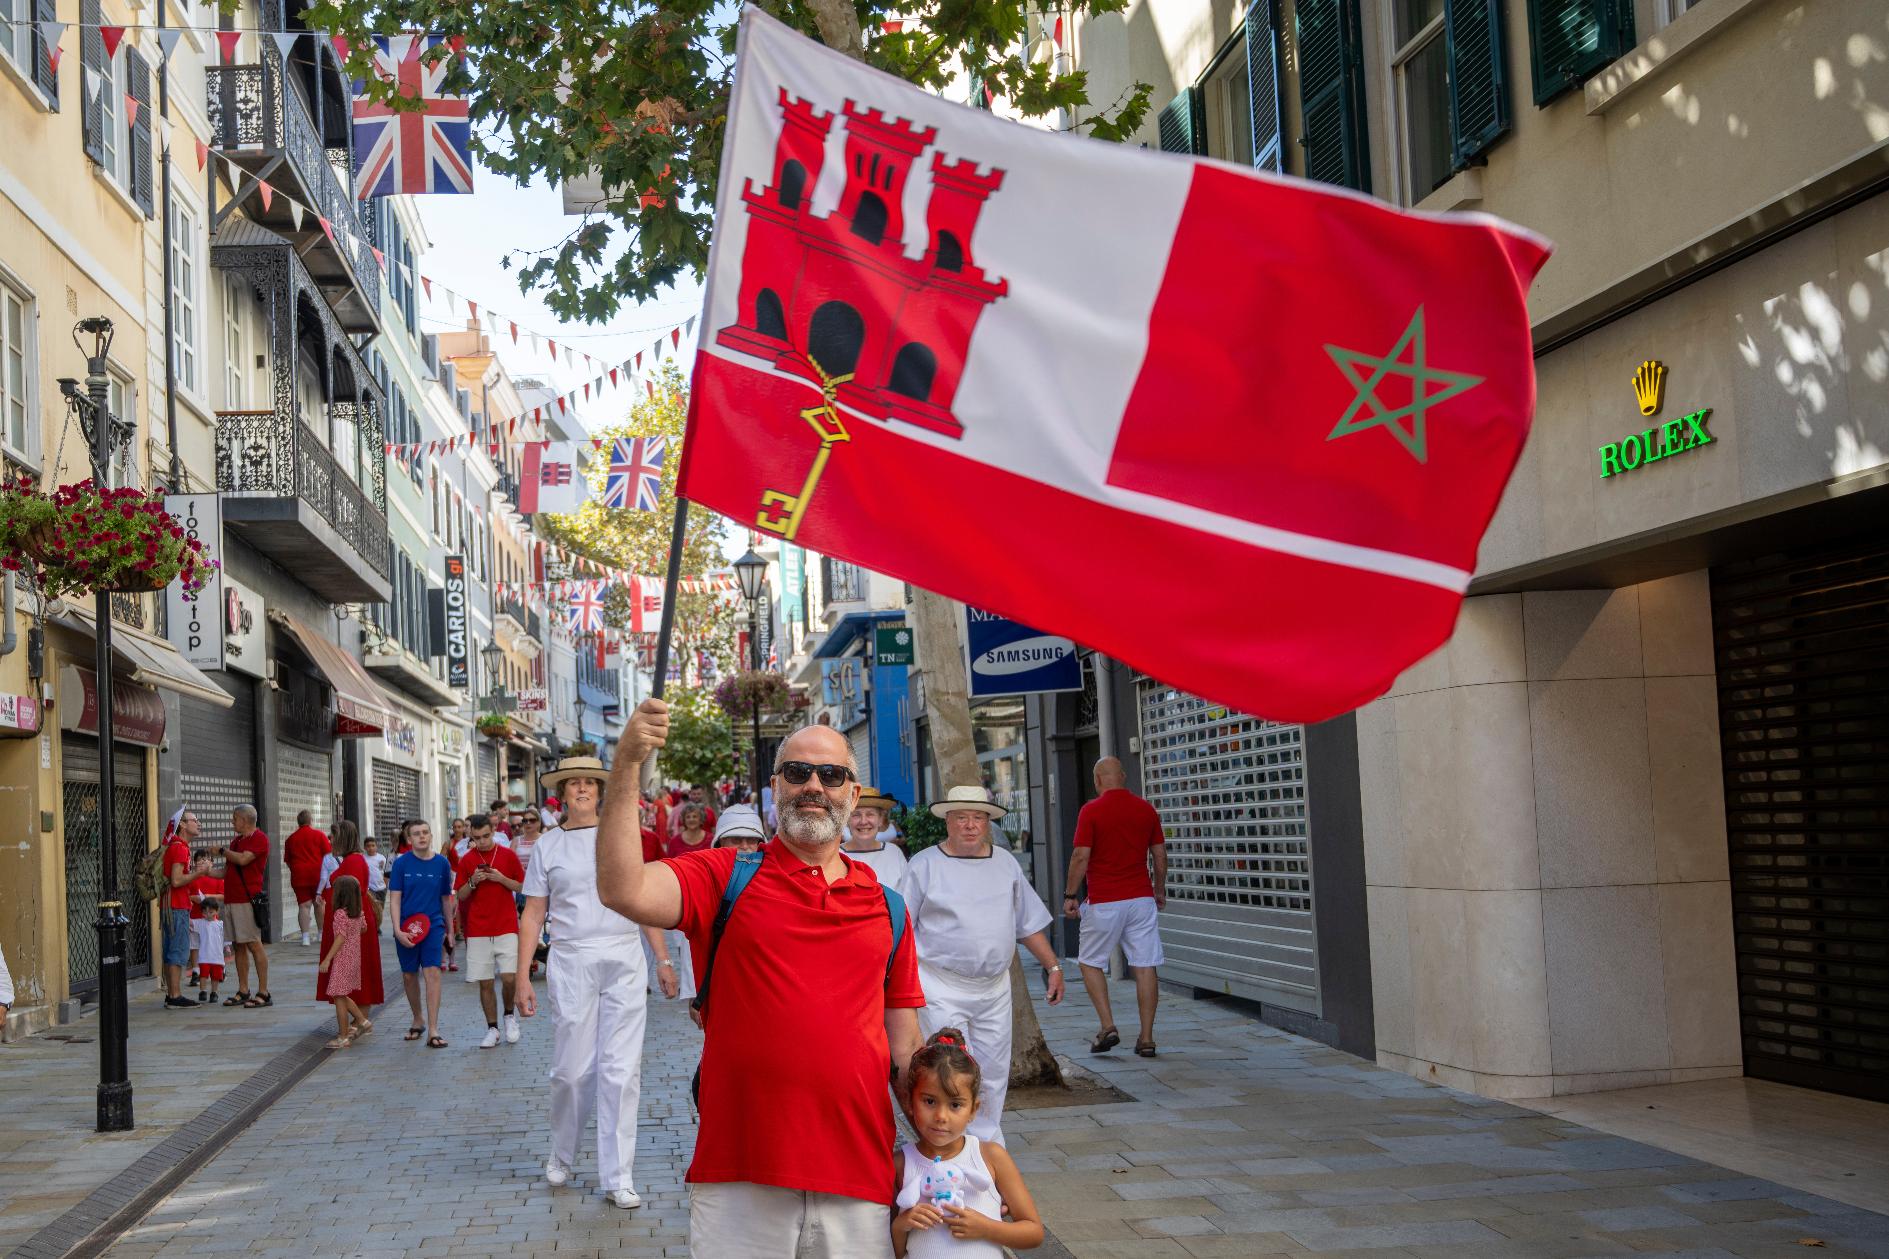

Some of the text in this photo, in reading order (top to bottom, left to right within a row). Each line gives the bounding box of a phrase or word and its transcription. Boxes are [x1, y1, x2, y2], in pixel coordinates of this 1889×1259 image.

[1599, 408, 1711, 478] ROLEX
[879, 653, 896, 663] TN
[986, 647, 1064, 664] SAMSUNG
